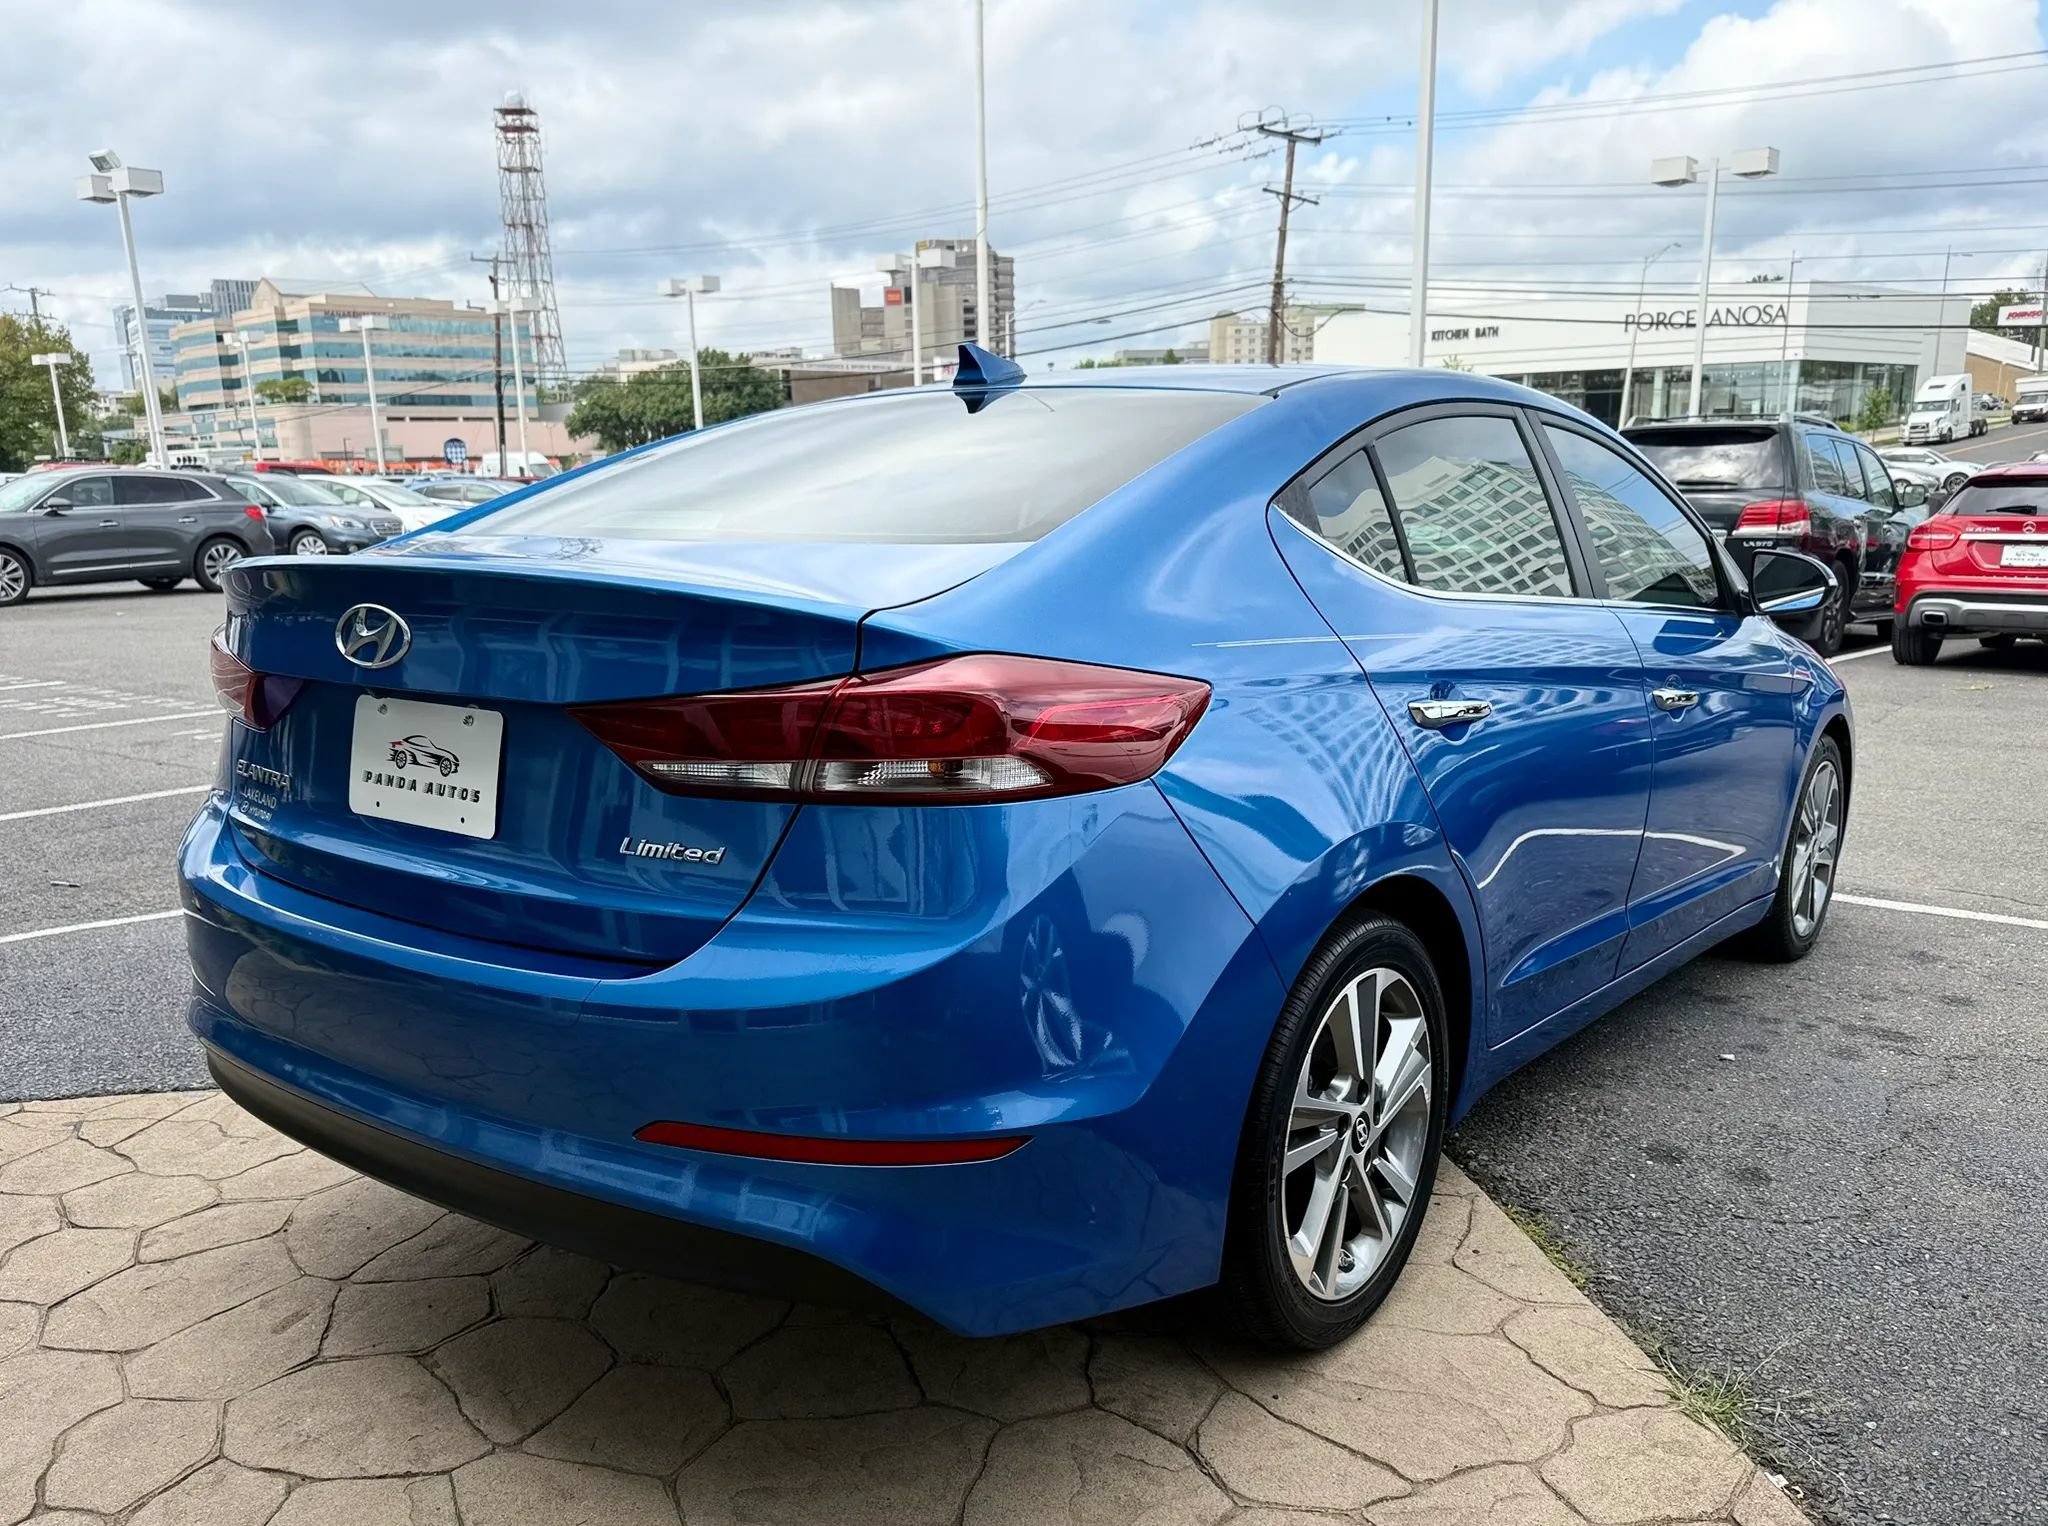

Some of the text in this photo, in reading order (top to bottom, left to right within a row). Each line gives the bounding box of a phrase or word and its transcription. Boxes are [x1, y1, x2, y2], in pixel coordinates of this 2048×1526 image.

[1624, 304, 1787, 333] PORCEANOSA
[2006, 310, 2043, 320] JOHNSO
[1431, 326, 1499, 341] KITCHEN BATH
[236, 759, 291, 791] ELANTRA
[363, 770, 480, 803] PANDA AUTOS
[241, 785, 277, 809] LAKELAND
[619, 836, 726, 865] Limited
